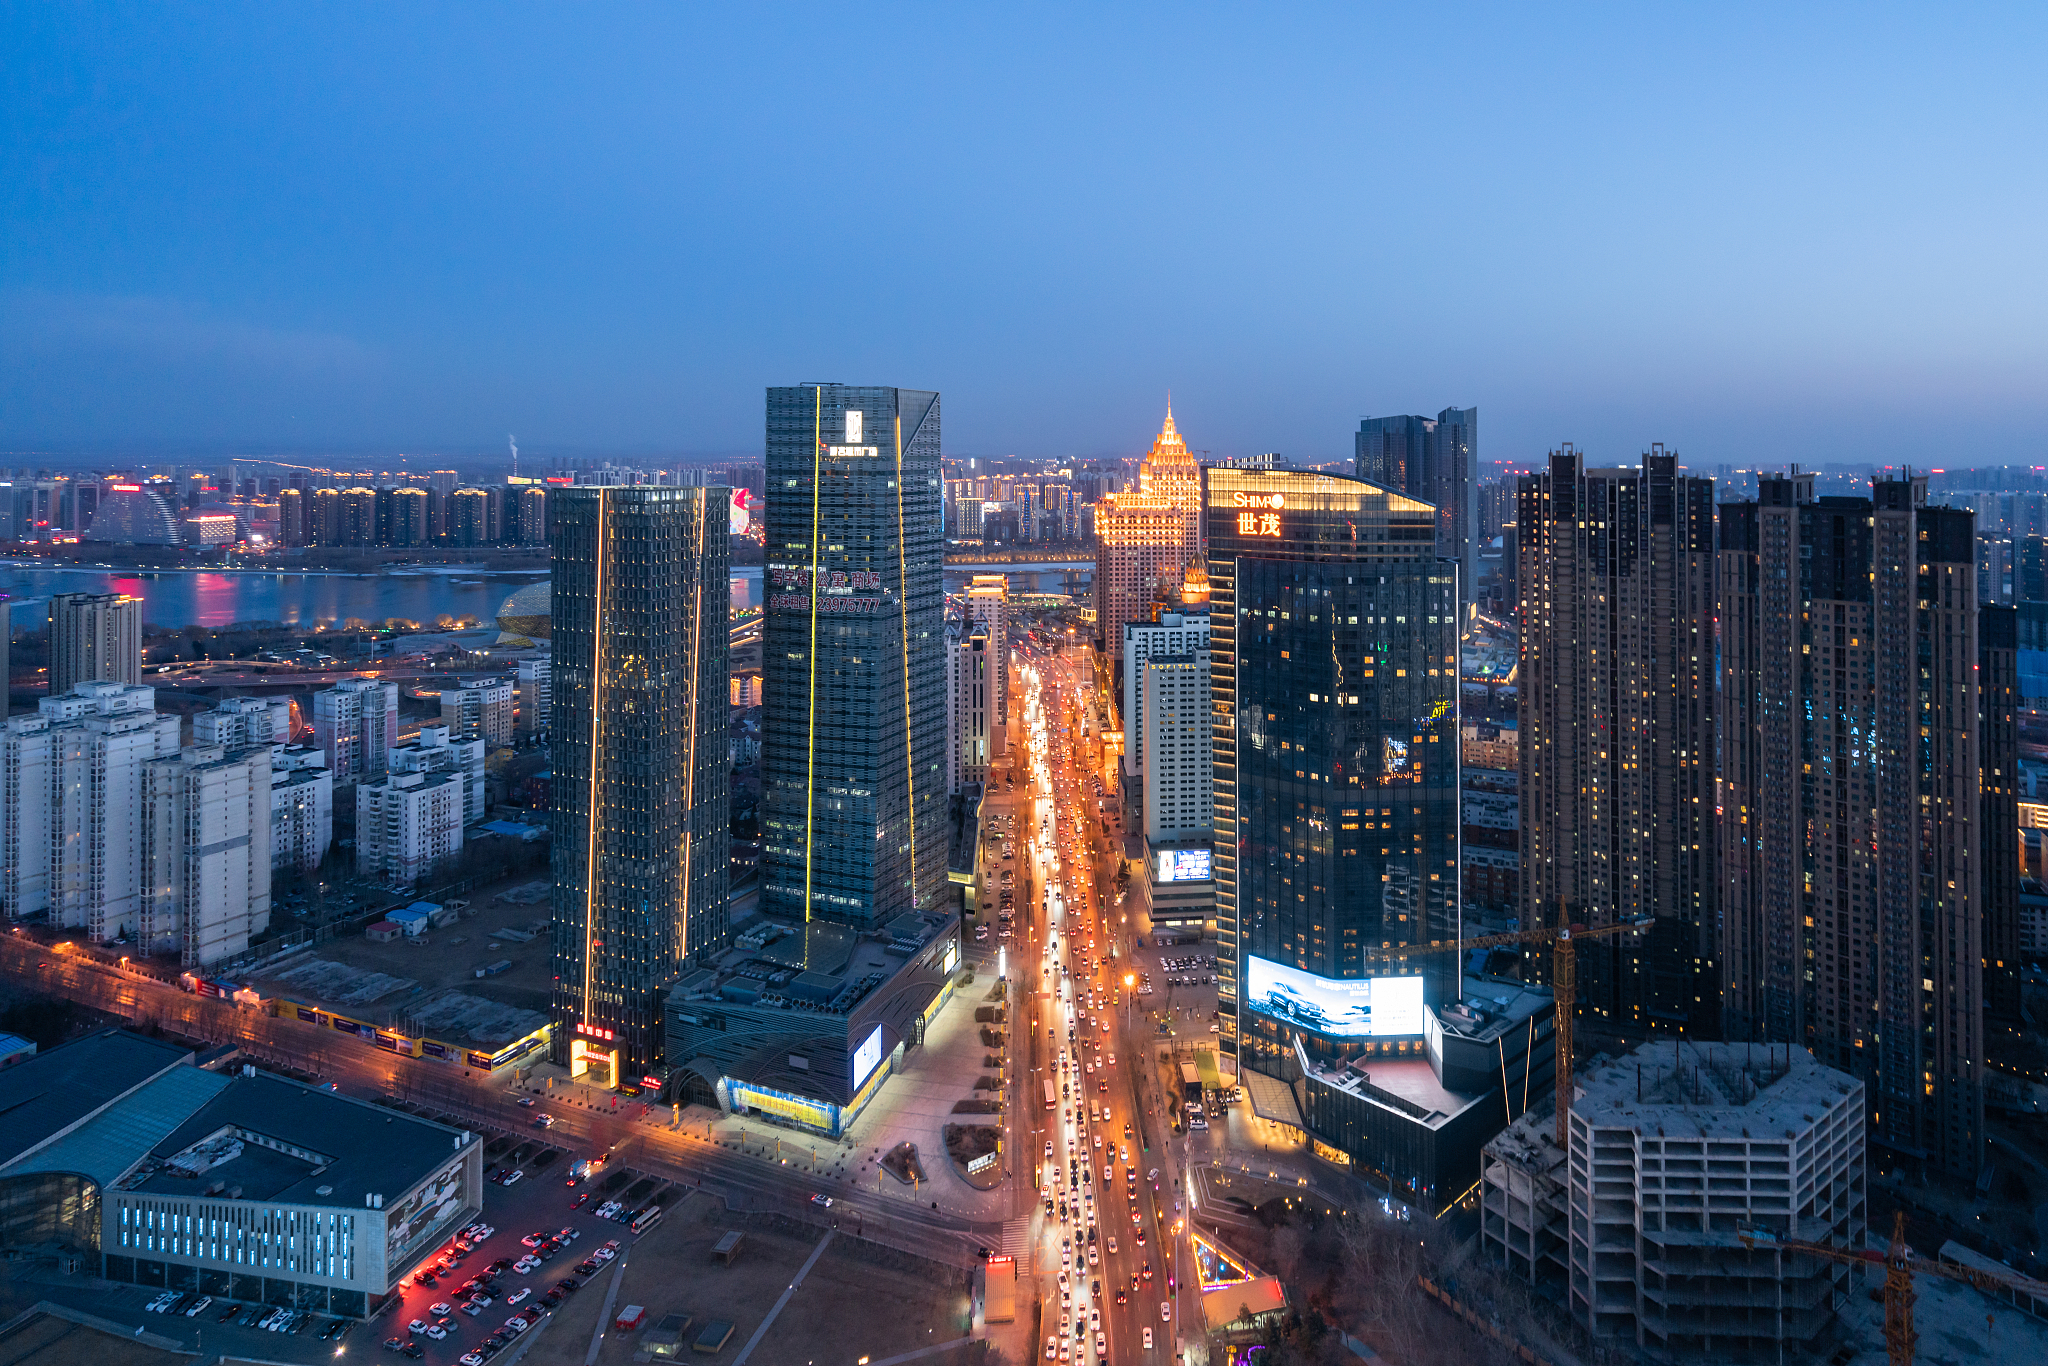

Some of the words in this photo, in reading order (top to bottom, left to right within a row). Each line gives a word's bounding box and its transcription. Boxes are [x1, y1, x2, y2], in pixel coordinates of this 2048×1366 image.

[1236, 512, 1281, 537] 世茂
[772, 569, 808, 587] 写字楼
[816, 571, 846, 589] 公寓
[851, 571, 880, 589] 商场
[770, 594, 809, 610] 全球租售
[816, 597, 880, 613] 23975777
